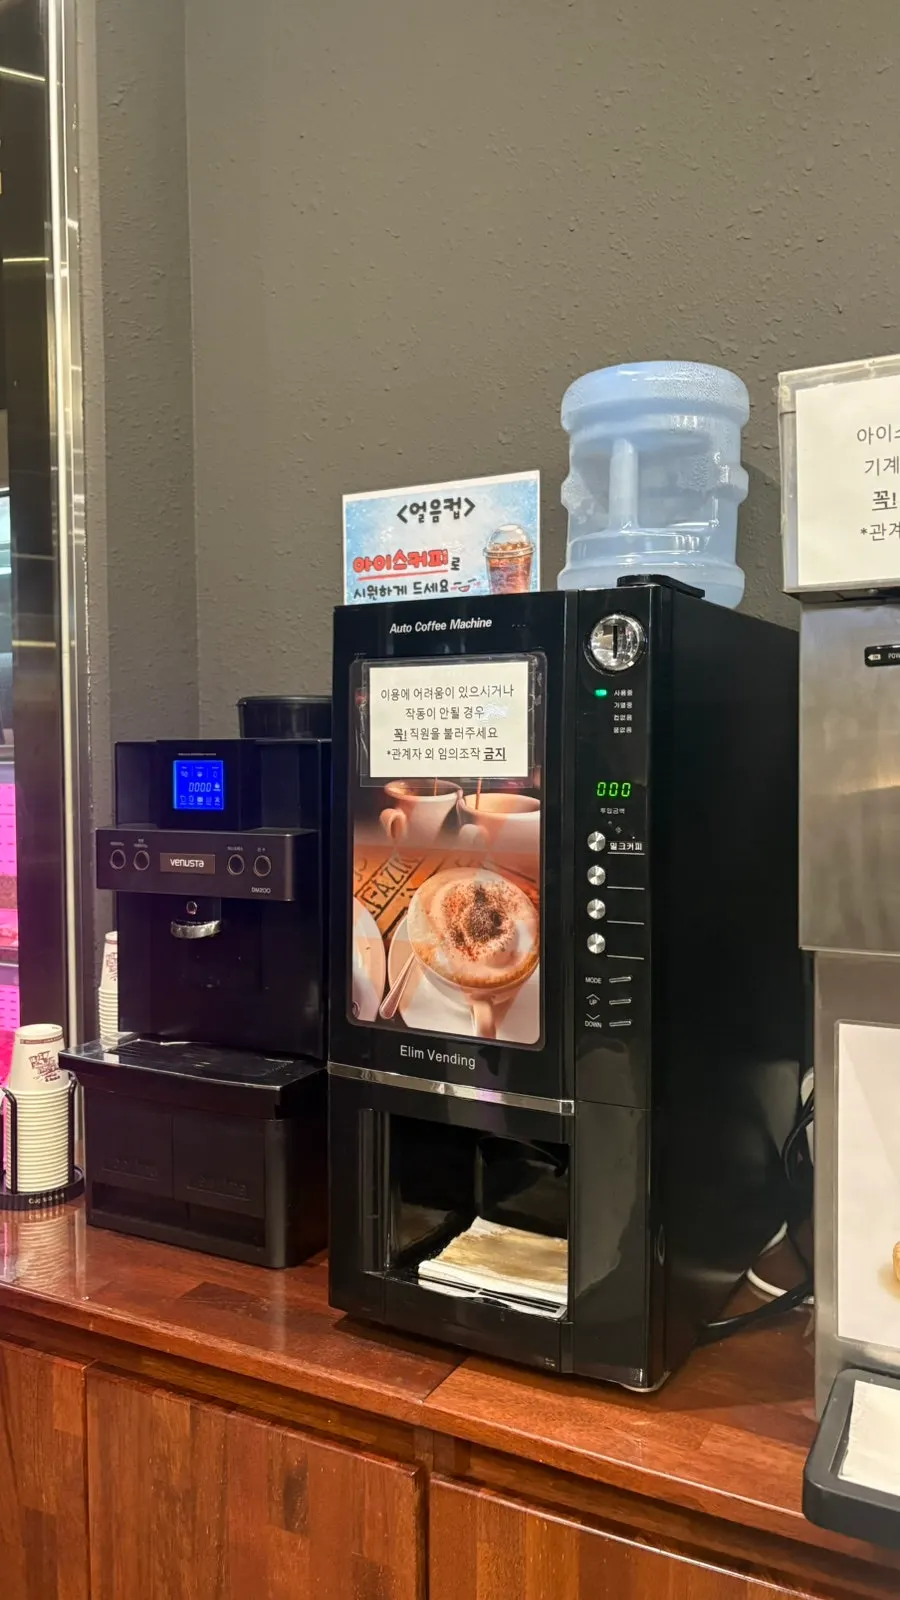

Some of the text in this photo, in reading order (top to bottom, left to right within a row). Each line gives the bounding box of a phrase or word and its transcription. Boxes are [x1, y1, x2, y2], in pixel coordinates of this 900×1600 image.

[864, 455, 900, 476] 기계
[872, 490, 897, 511] 꼭!
[353, 579, 449, 601] 시원하게 드세요
[389, 617, 492, 634] Auto Coffee Machine
[381, 684, 514, 701] 이용에 어려움이 있으시거나
[405, 705, 485, 720] 작동이 안될 경우
[393, 727, 498, 741] 꼭! 직원을 불러주세요
[425, 748, 434, 761] 외
[439, 748, 480, 760] 임의조작
[483, 747, 507, 761] 금지
[596, 781, 632, 798] 000
[610, 842, 642, 851] 밀크커피
[584, 976, 602, 984] MODE
[584, 1020, 602, 1028] DOWN
[400, 1045, 476, 1070] Elim Vending
